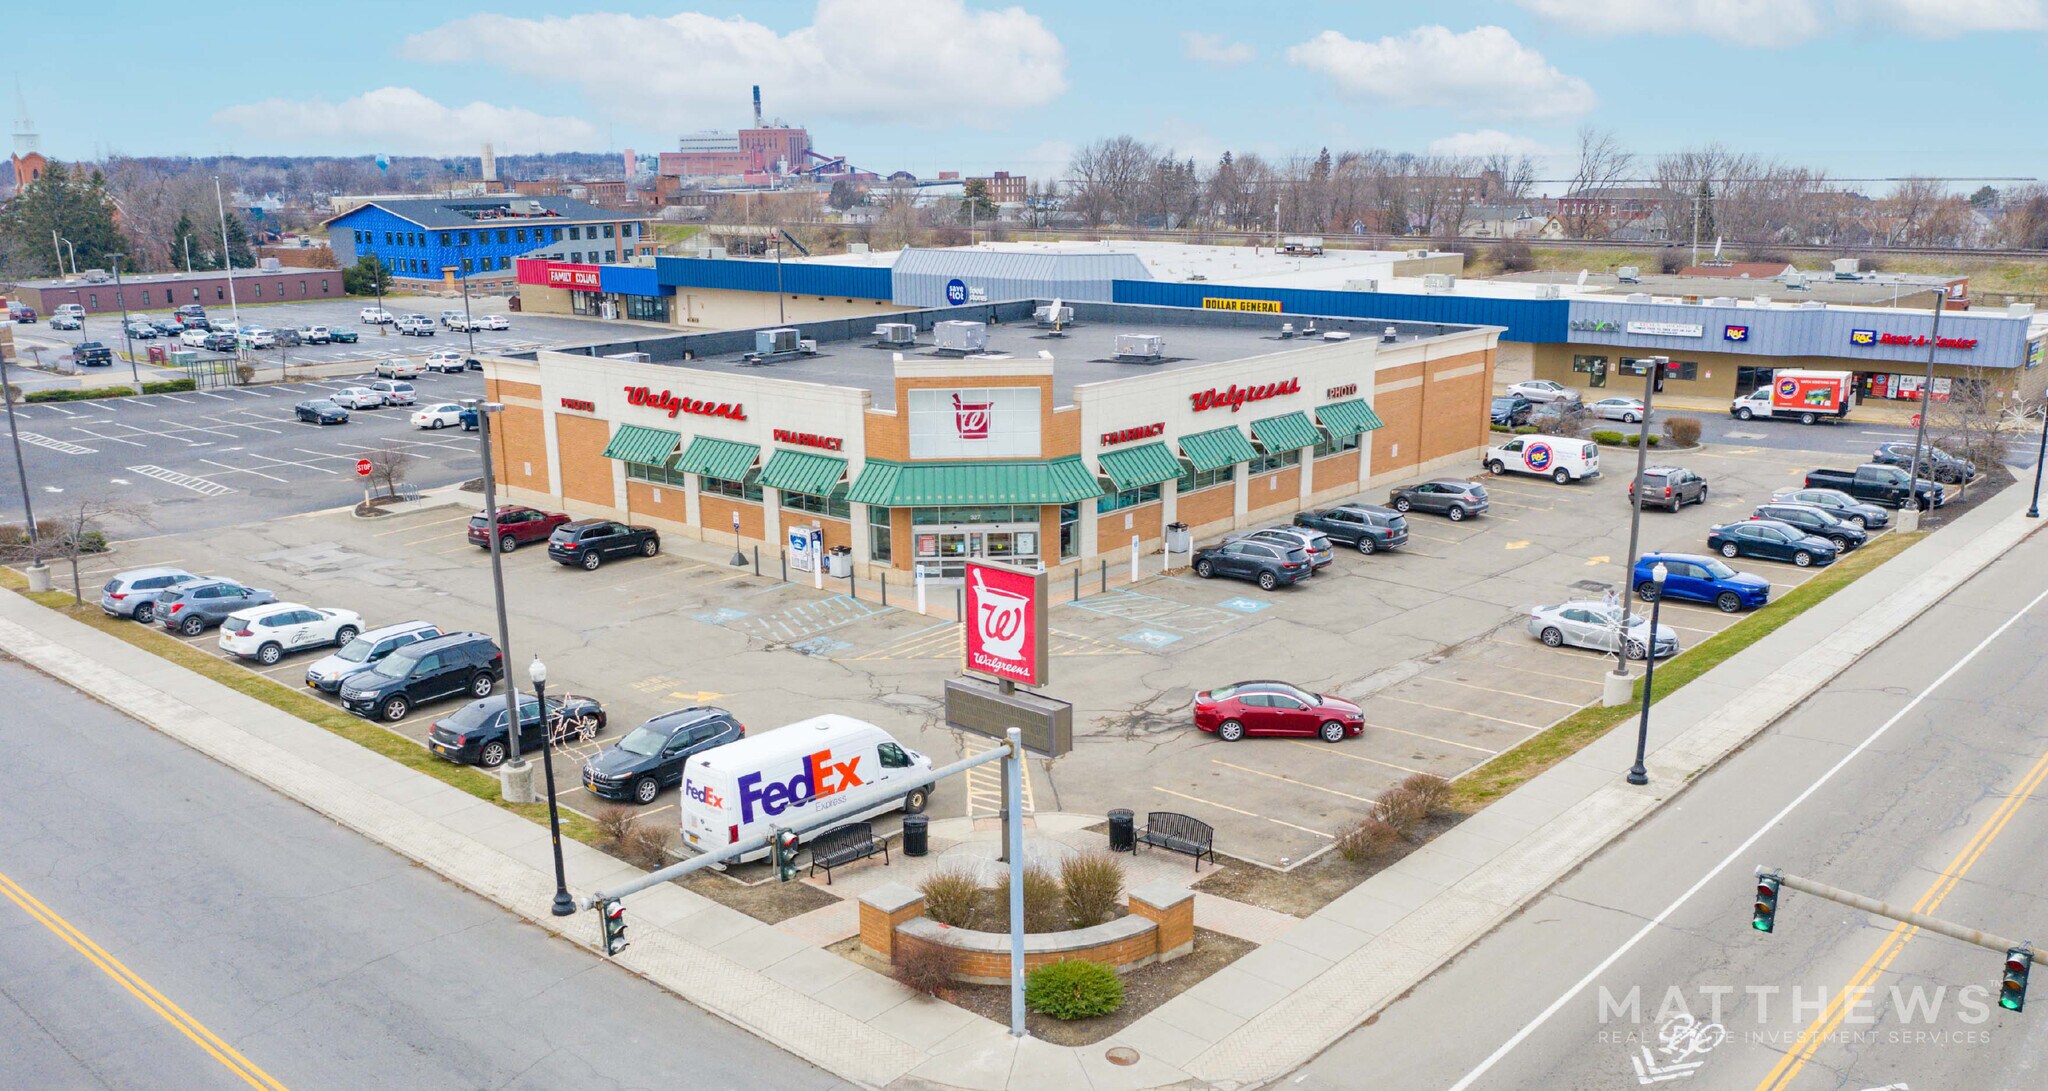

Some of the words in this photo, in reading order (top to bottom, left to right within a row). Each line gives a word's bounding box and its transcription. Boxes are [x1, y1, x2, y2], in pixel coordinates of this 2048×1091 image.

[1205, 299, 1237, 311] DOLLAR
[1240, 301, 1278, 313] GENERAL
[1727, 328, 1745, 339] RAC
[1191, 377, 1301, 412] Walgreens
[1327, 383, 1357, 399] PHOTO
[561, 398, 594, 412] PHOTO
[624, 386, 748, 421] Walgreens
[773, 429, 843, 452] PHARMACY
[1101, 422, 1166, 447] PHARMACY
[973, 652, 1031, 677] Walgreens
[685, 778, 724, 809] FedEx
[738, 749, 864, 824] FedEx
[815, 794, 847, 812] Express
